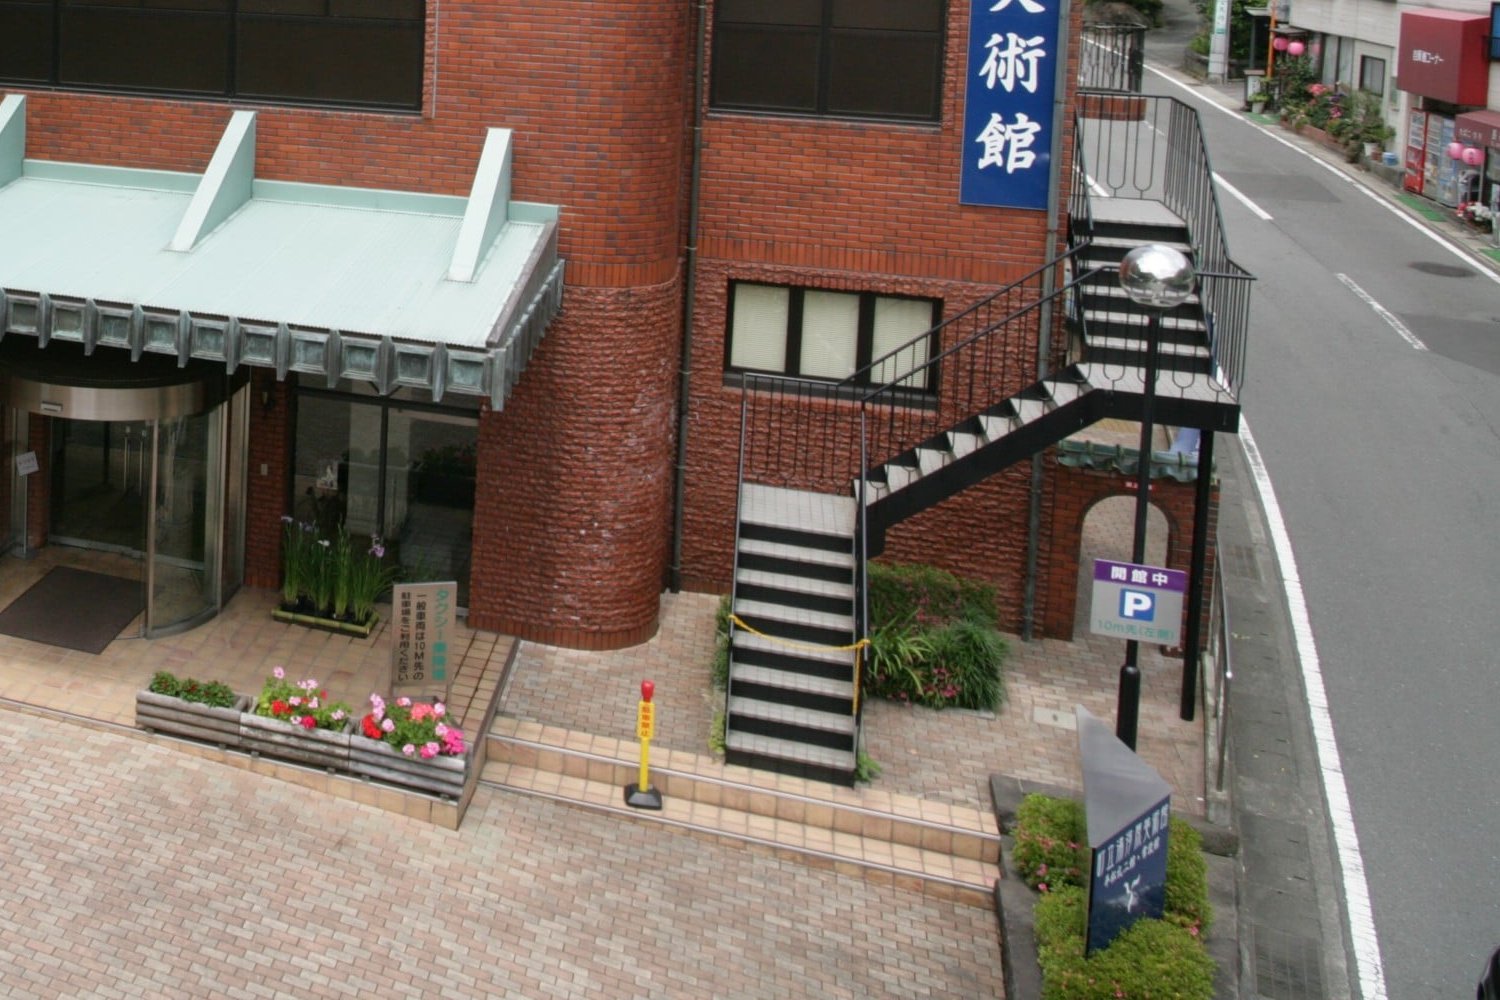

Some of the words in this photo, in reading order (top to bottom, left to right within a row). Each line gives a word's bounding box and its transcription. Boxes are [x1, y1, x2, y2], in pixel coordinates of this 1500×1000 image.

[1110, 565, 1168, 586] 開館中
[1123, 591, 1152, 617] P
[398, 591, 411, 682] 駐車場をご利用ください
[412, 593, 427, 681] 一般車両は10M先の
